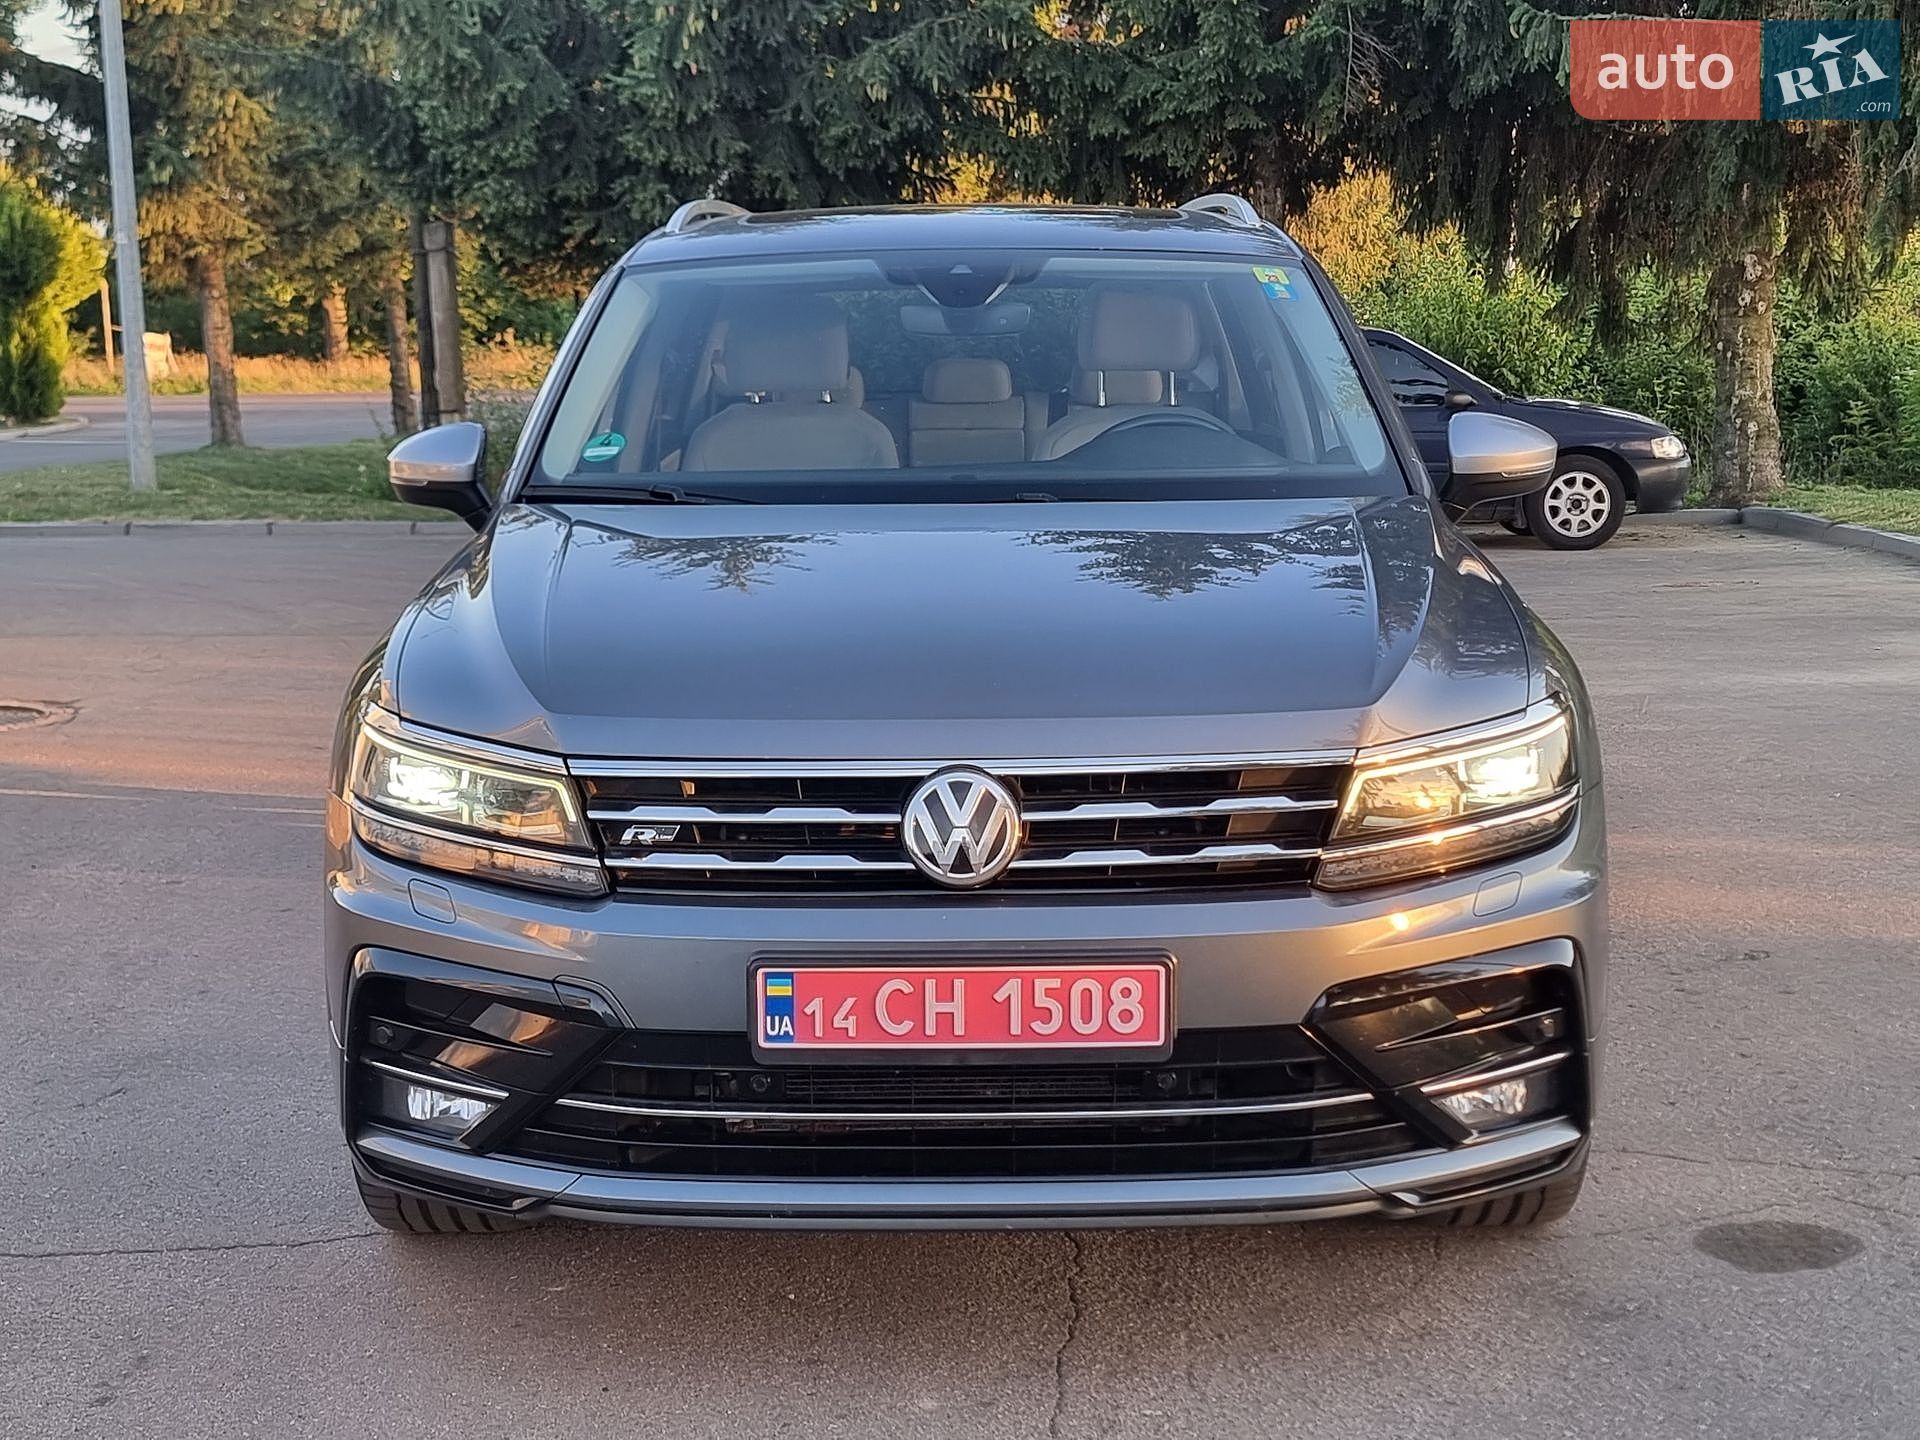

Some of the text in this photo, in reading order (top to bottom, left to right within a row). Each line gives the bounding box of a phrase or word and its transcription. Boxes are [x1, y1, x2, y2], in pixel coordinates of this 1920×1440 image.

[905, 772, 1020, 886] VW
[766, 1015, 794, 1036] UA
[803, 976, 1145, 1038] 14 CH 1508
